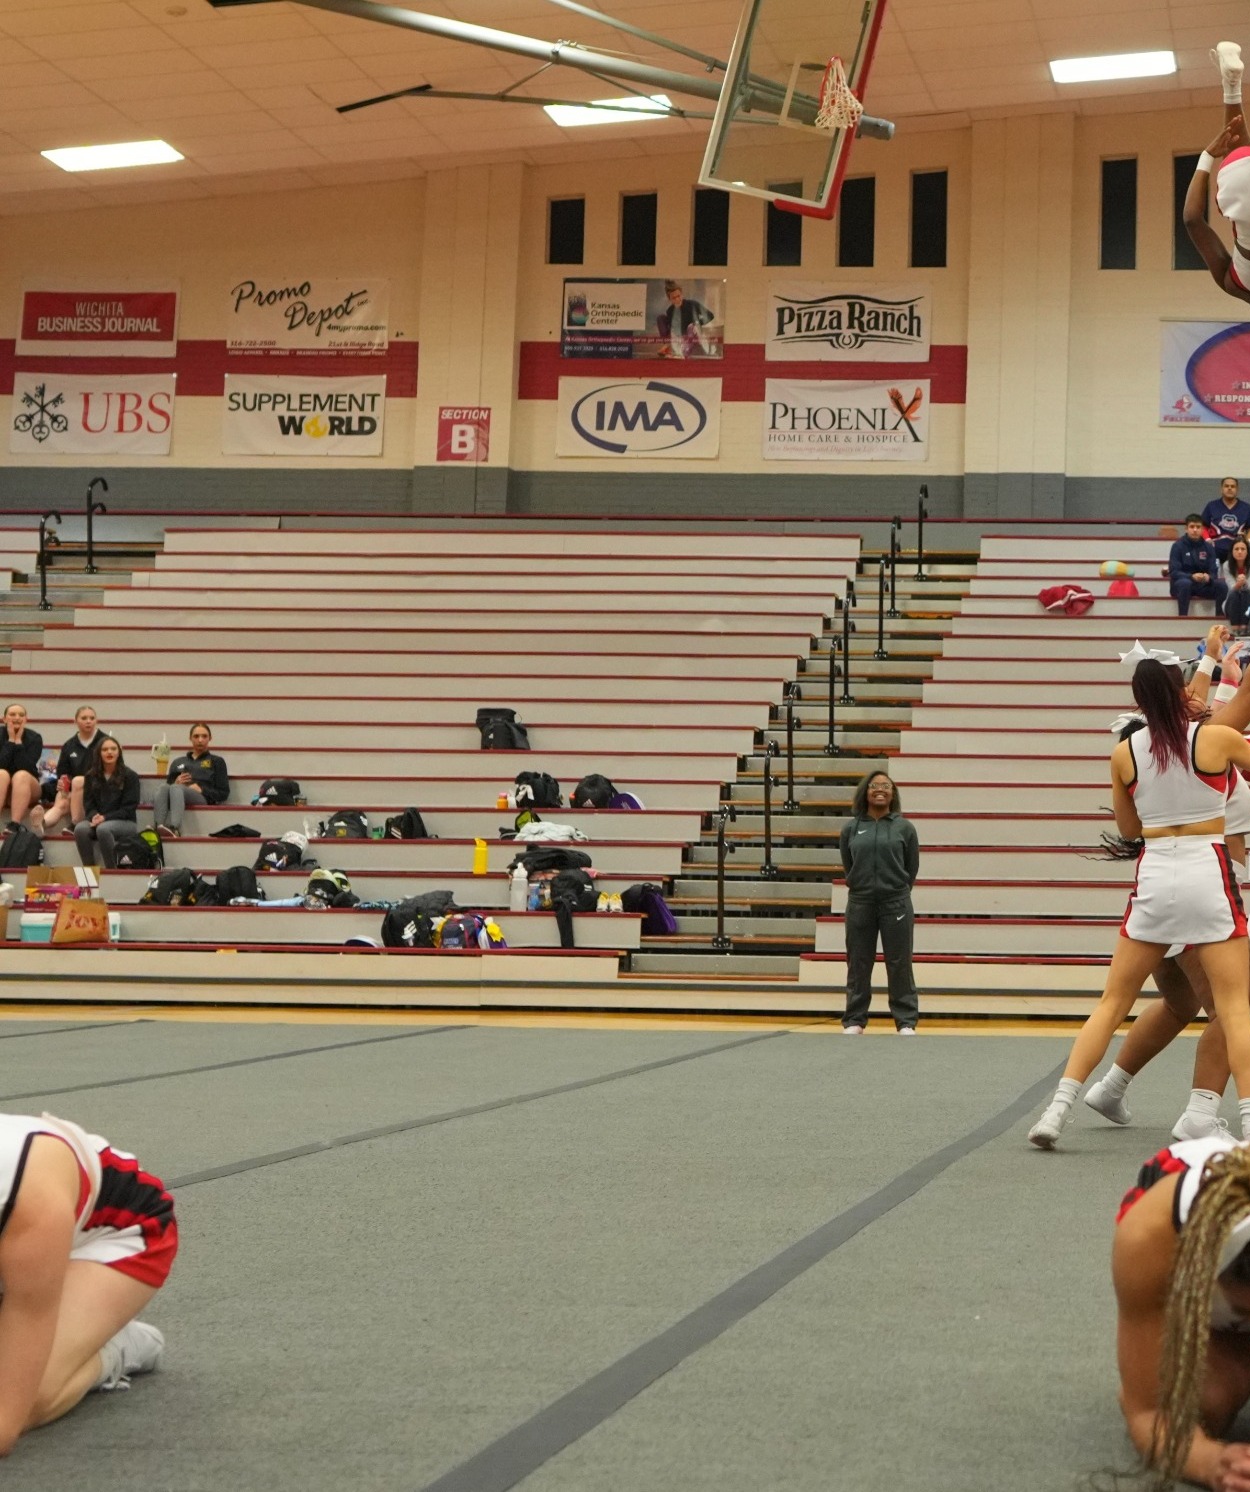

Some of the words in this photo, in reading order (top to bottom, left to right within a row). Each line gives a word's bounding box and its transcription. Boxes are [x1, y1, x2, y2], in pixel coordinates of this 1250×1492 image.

[231, 281, 310, 313] Promo
[590, 301, 620, 310] Kansas
[75, 301, 124, 317] WICHITA
[285, 289, 368, 336] Depot
[590, 309, 643, 318] Orthopaedic
[776, 306, 842, 336] Pizza
[847, 301, 922, 337] Ranch
[37, 316, 100, 332] BUSINESS
[102, 317, 161, 333] JOURNAL
[590, 317, 618, 325] Center
[80, 391, 171, 434] UBS
[228, 392, 380, 413] SUPPLEMENT
[441, 408, 489, 420] SECTION
[595, 401, 684, 431] IMA
[769, 387, 924, 443] PHOENIX
[451, 424, 475, 455] B
[768, 434, 803, 443] HOME
[808, 434, 841, 443] CARE
[844, 434, 852, 443] &
[857, 434, 909, 443] HOSPICE
